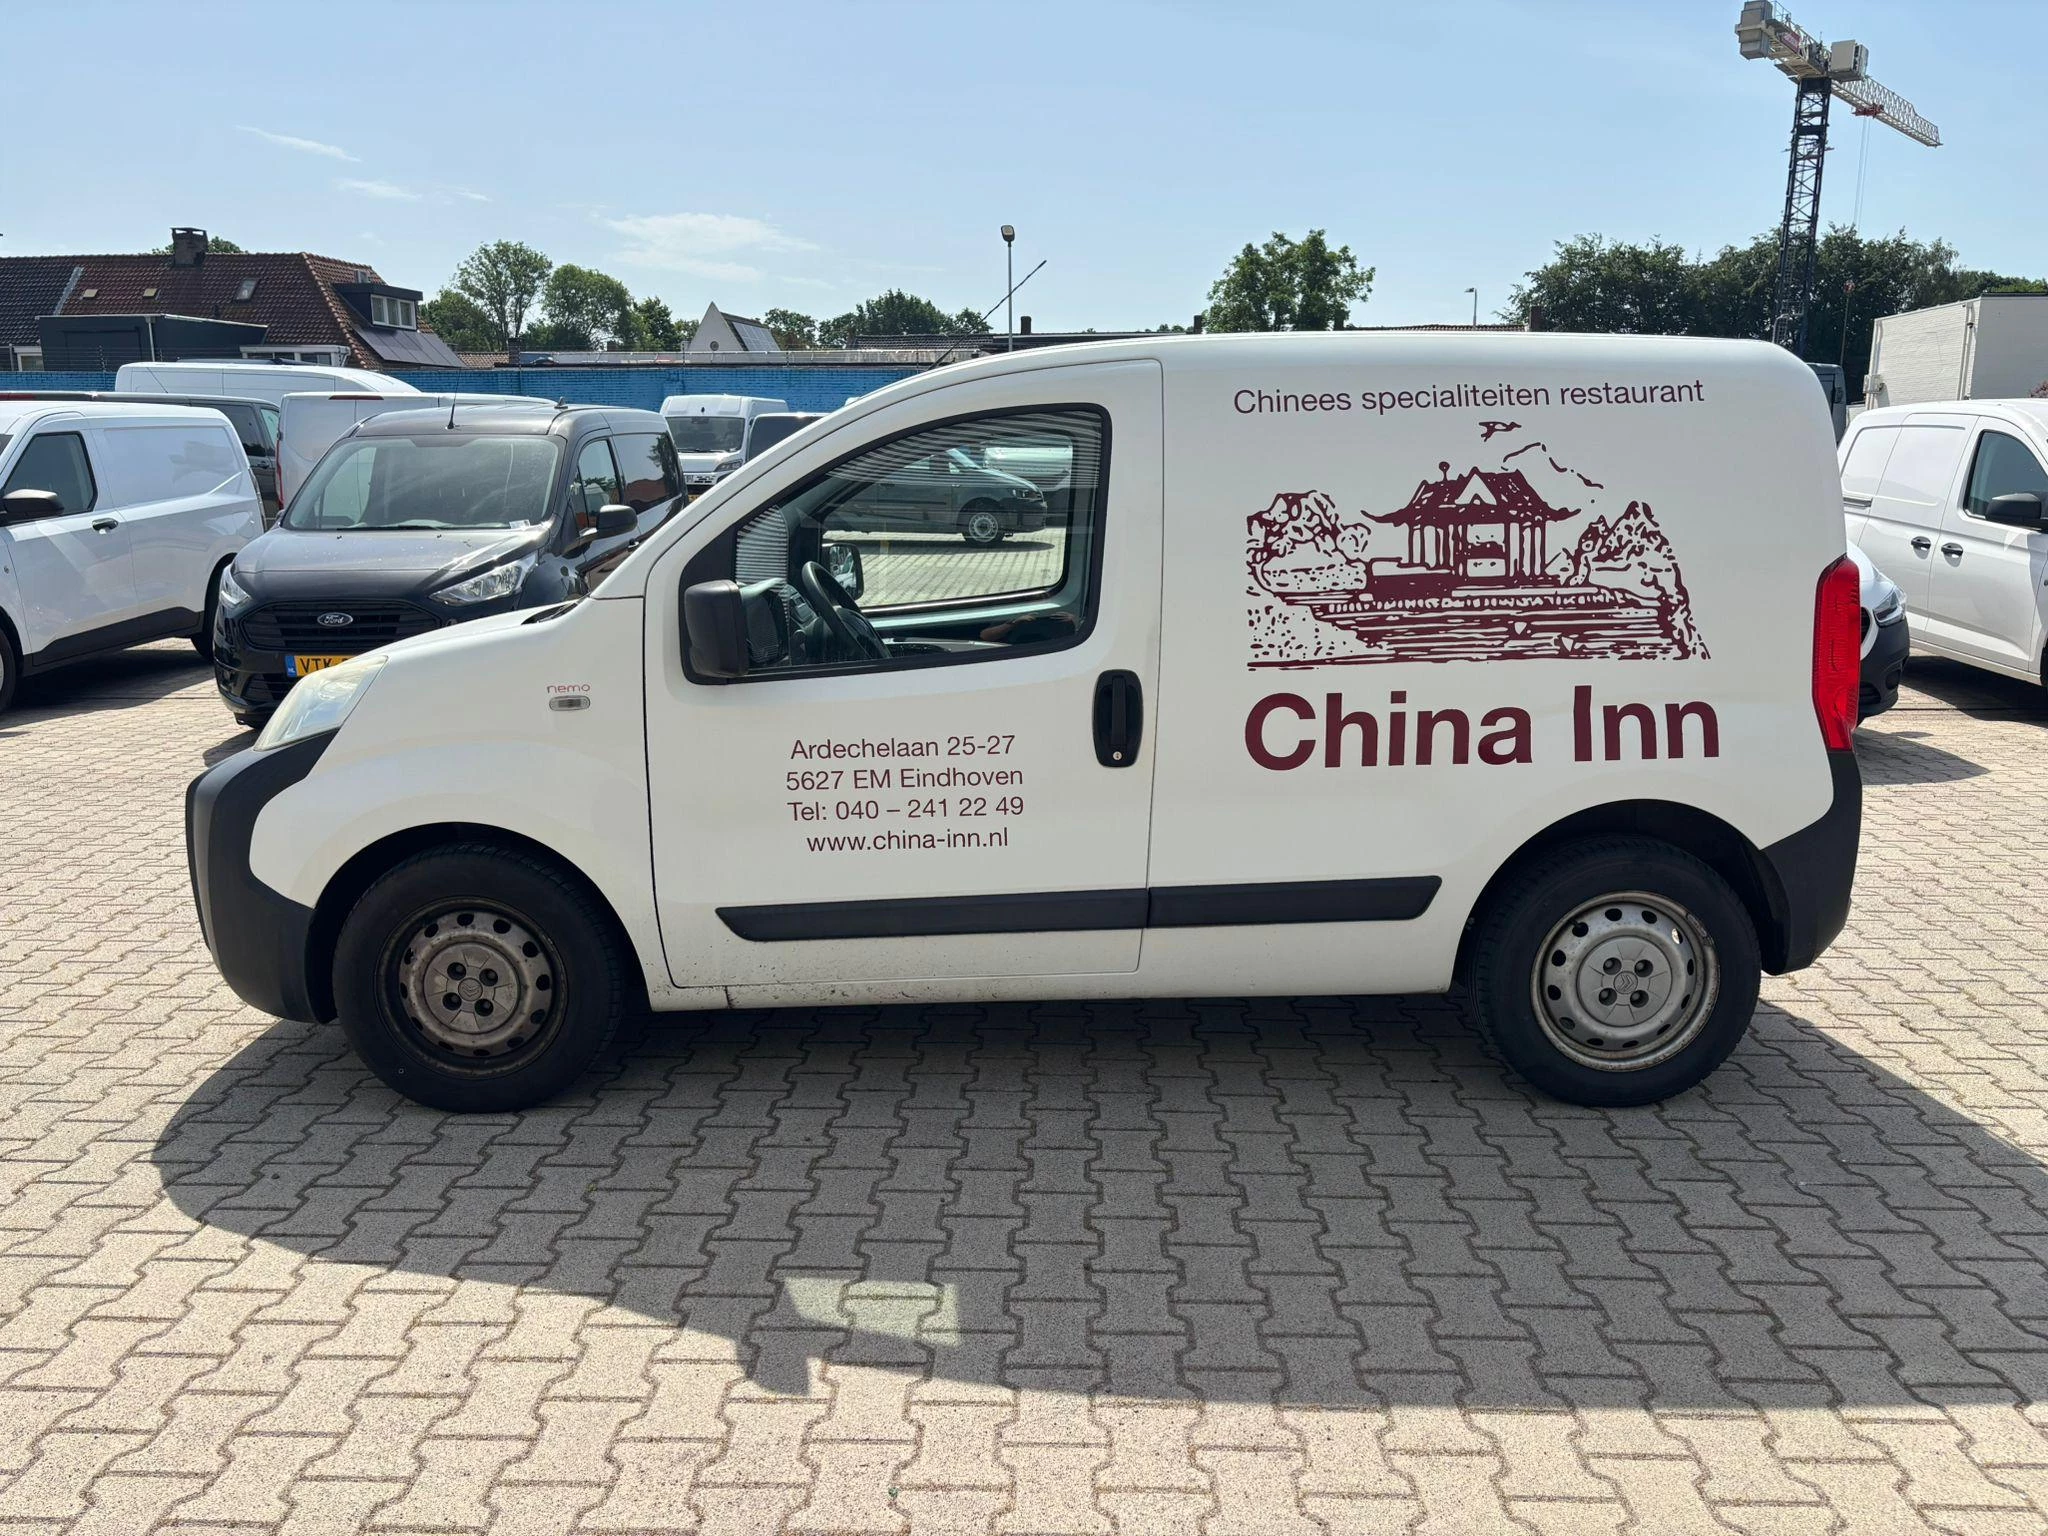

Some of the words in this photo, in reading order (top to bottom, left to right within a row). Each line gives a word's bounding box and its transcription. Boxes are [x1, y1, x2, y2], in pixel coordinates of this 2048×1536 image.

[1233, 388, 1352, 415] Chinees
[1361, 382, 1550, 416] specialiteiten
[1560, 379, 1705, 405] restaurant
[300, 658, 349, 673] VTK
[546, 683, 591, 694] nemo
[1244, 690, 1533, 771] China
[1572, 684, 1720, 762] Inn
[790, 737, 939, 760] Ardechelaan
[947, 734, 1016, 756] 25-27
[786, 770, 844, 791] 5627
[853, 768, 891, 789] EM
[900, 767, 1023, 788] Eindhoven
[787, 801, 827, 822] Tel:
[835, 800, 879, 821] 040
[907, 798, 947, 819] 241
[959, 797, 987, 817] 22
[995, 796, 1024, 816] 49
[806, 826, 1008, 852] www.china-inn.nl
